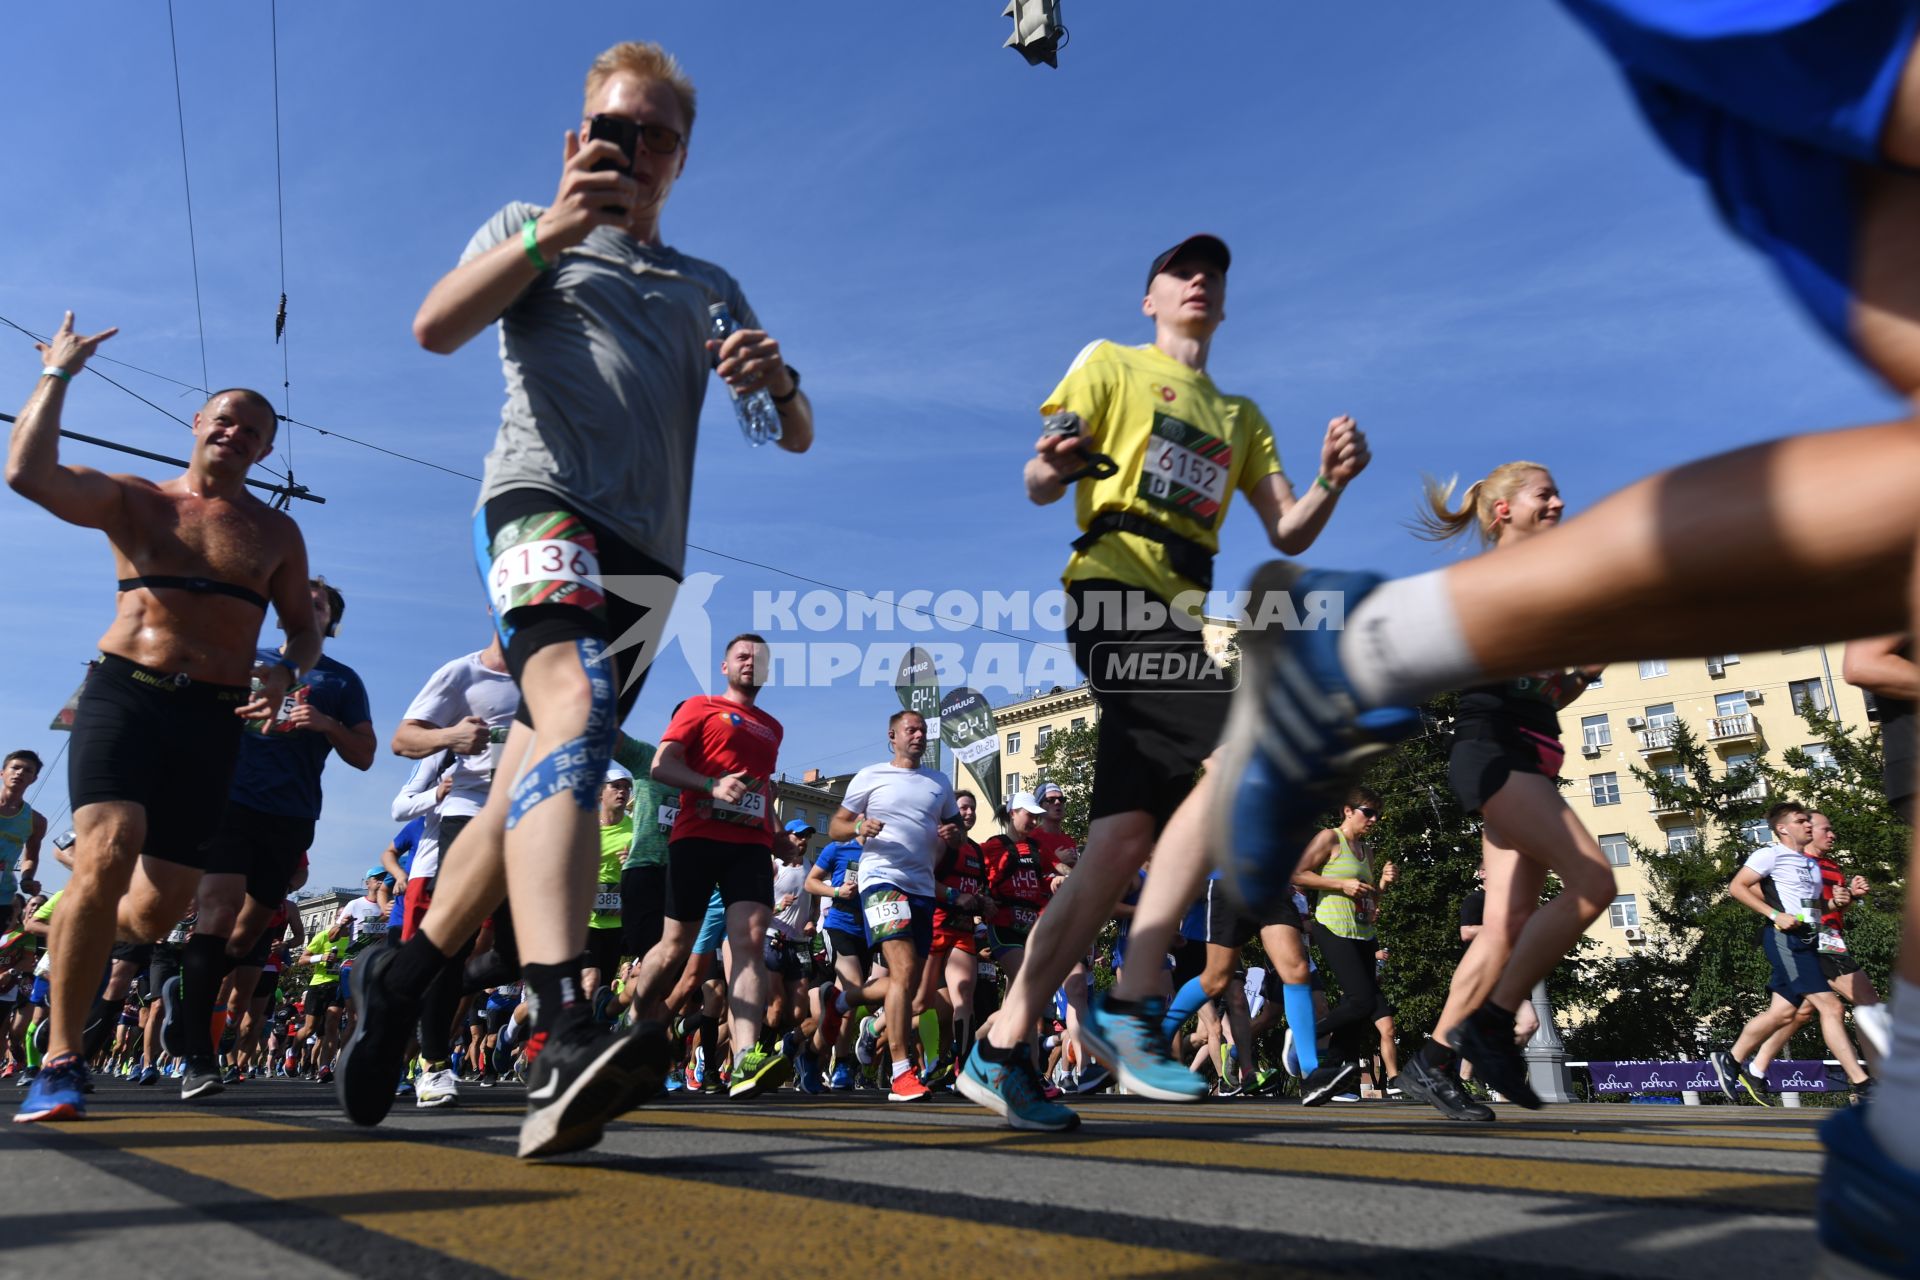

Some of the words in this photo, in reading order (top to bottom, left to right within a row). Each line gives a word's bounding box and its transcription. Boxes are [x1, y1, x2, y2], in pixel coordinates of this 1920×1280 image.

[1158, 447, 1218, 493] 6152
[1154, 478, 1166, 494] D
[496, 545, 589, 588] 6136
[1011, 870, 1039, 888] 1:49
[875, 902, 900, 919] 153
[1598, 1074, 1633, 1091] parkrun
[1641, 1072, 1677, 1090] parkrun
[1781, 1070, 1824, 1089] parkrun
